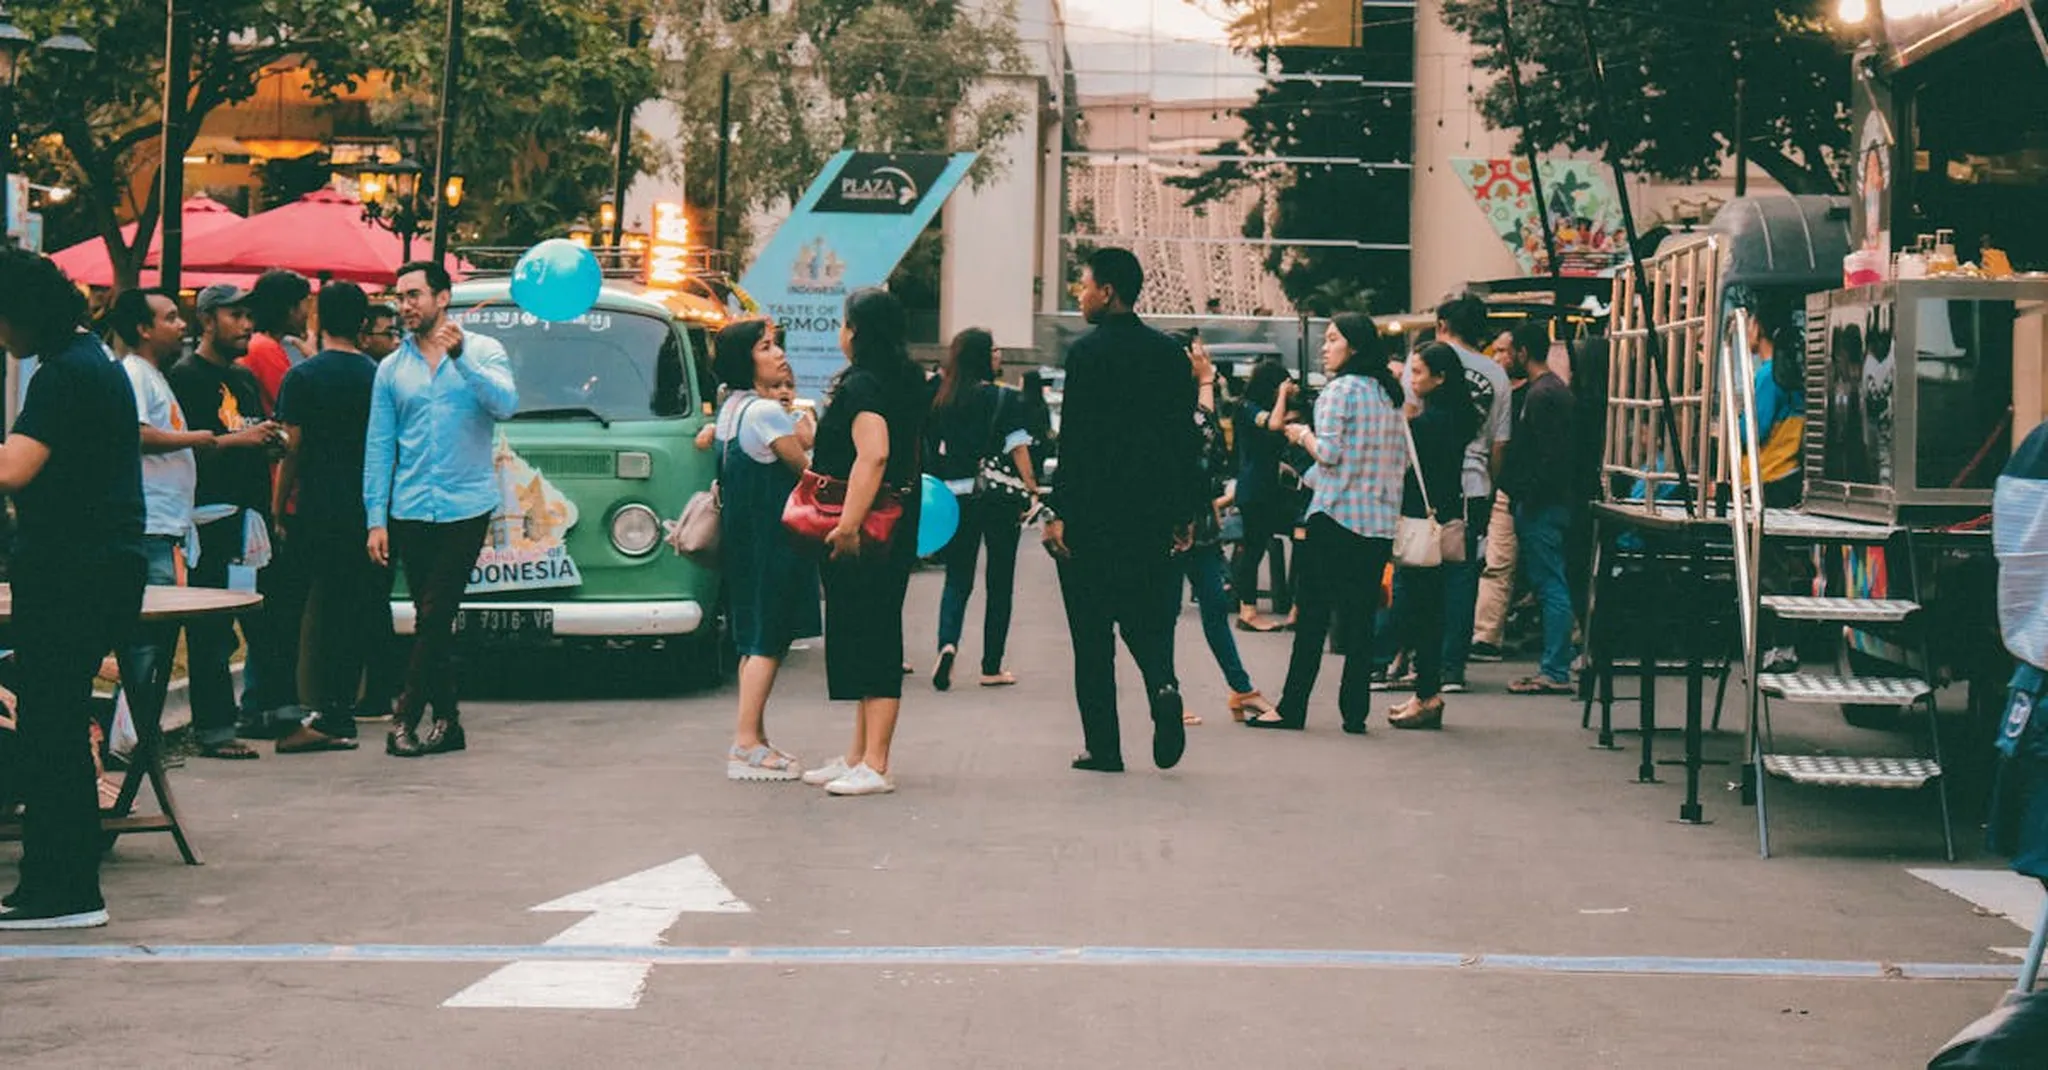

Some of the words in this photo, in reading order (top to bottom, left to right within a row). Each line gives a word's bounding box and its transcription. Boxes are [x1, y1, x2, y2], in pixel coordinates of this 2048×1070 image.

[841, 177, 896, 193] PLAZA
[767, 303, 814, 316] TASTE
[779, 315, 842, 333] RMON
[469, 559, 574, 585] DONESIA
